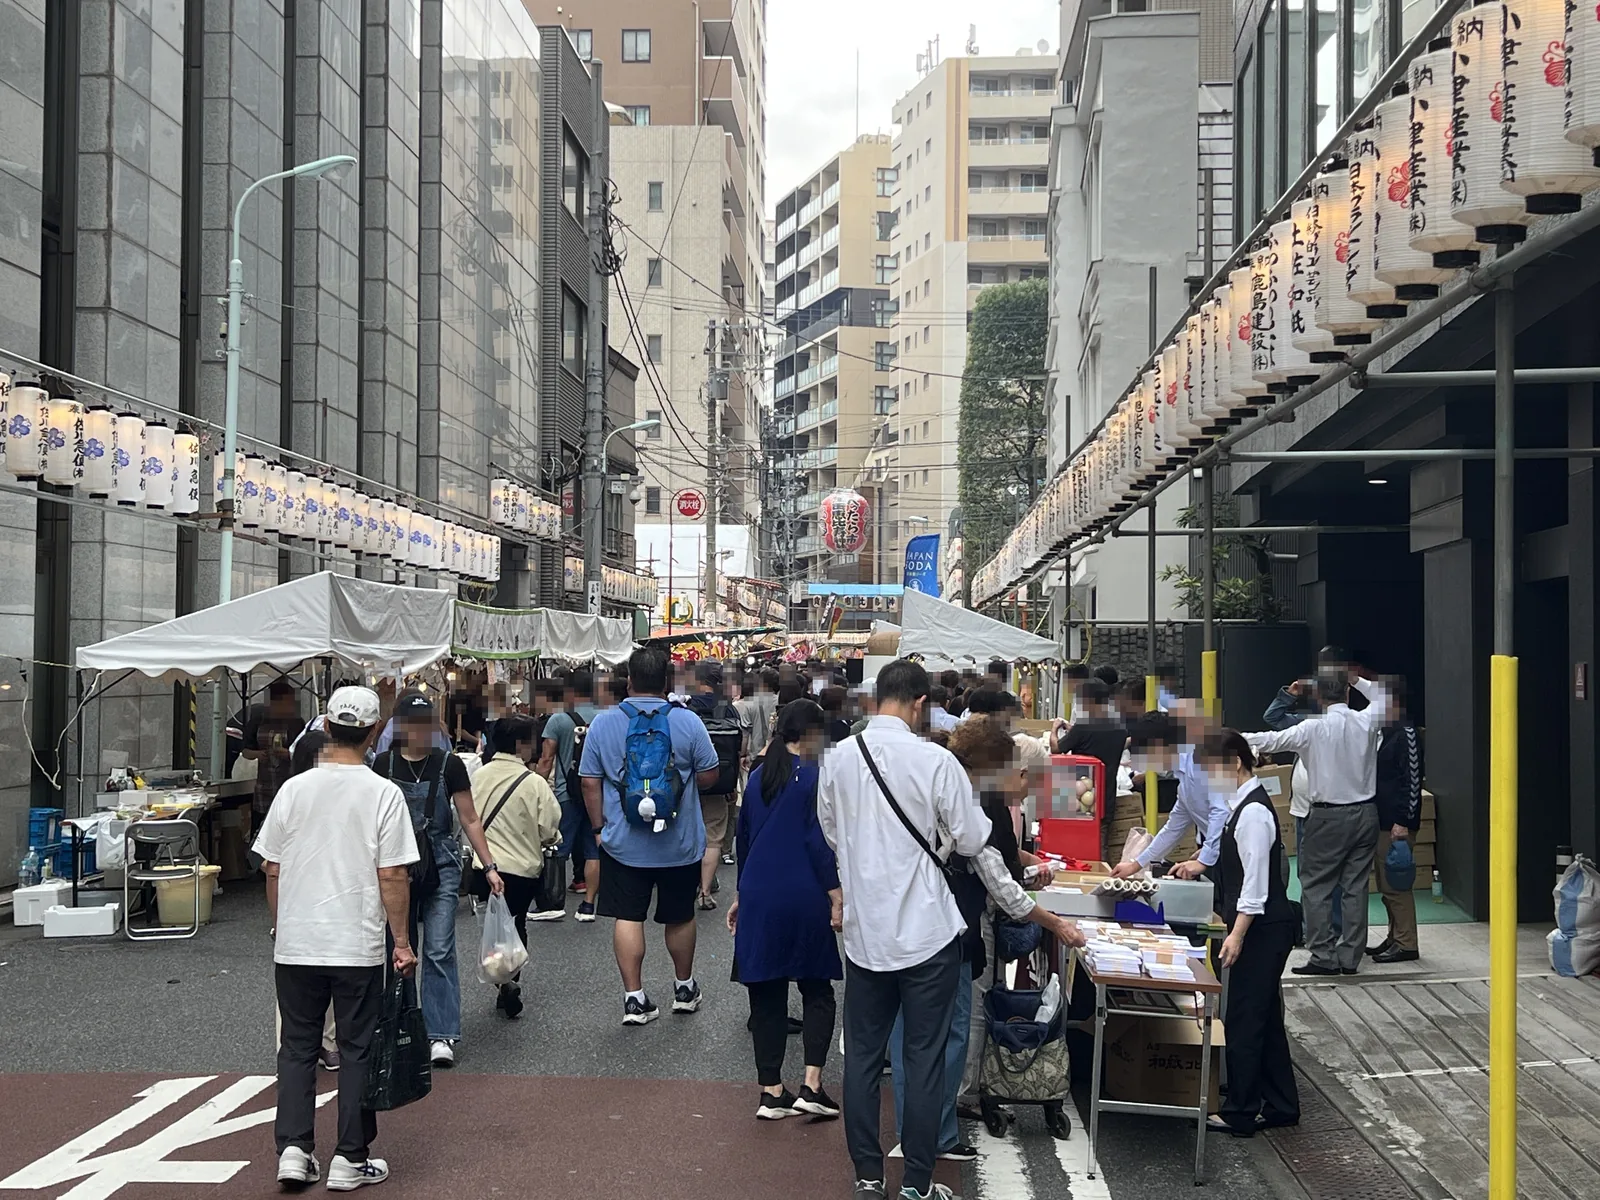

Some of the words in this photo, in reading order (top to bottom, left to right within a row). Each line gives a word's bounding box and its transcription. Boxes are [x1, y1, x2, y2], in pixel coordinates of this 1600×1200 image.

[1457, 17, 1483, 46] 納
[1413, 65, 1433, 90] 納
[189, 442, 199, 501] 佐川急便
[680, 500, 700, 509] 消火栓
